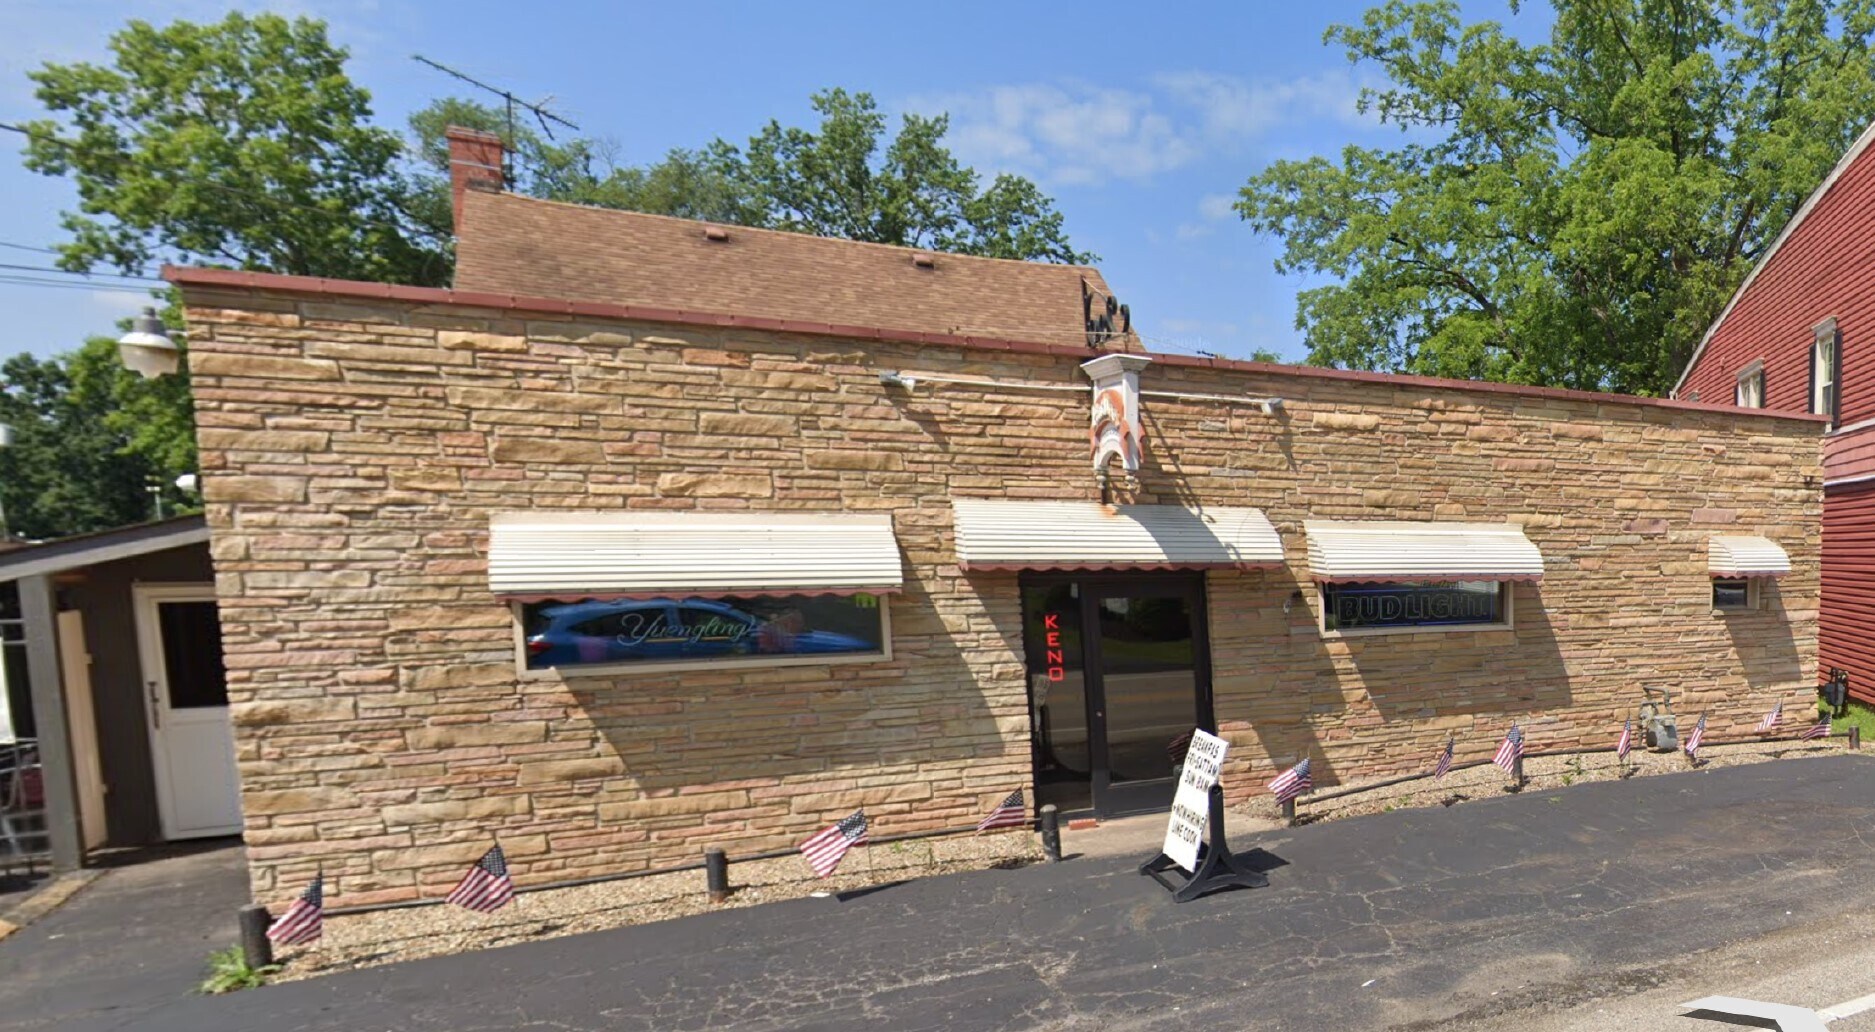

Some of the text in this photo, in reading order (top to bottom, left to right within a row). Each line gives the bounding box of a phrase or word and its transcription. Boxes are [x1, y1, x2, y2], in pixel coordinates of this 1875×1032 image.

[1338, 595, 1400, 622] BUD
[616, 613, 756, 647] Yuengling
[1045, 614, 1064, 681] KENO
